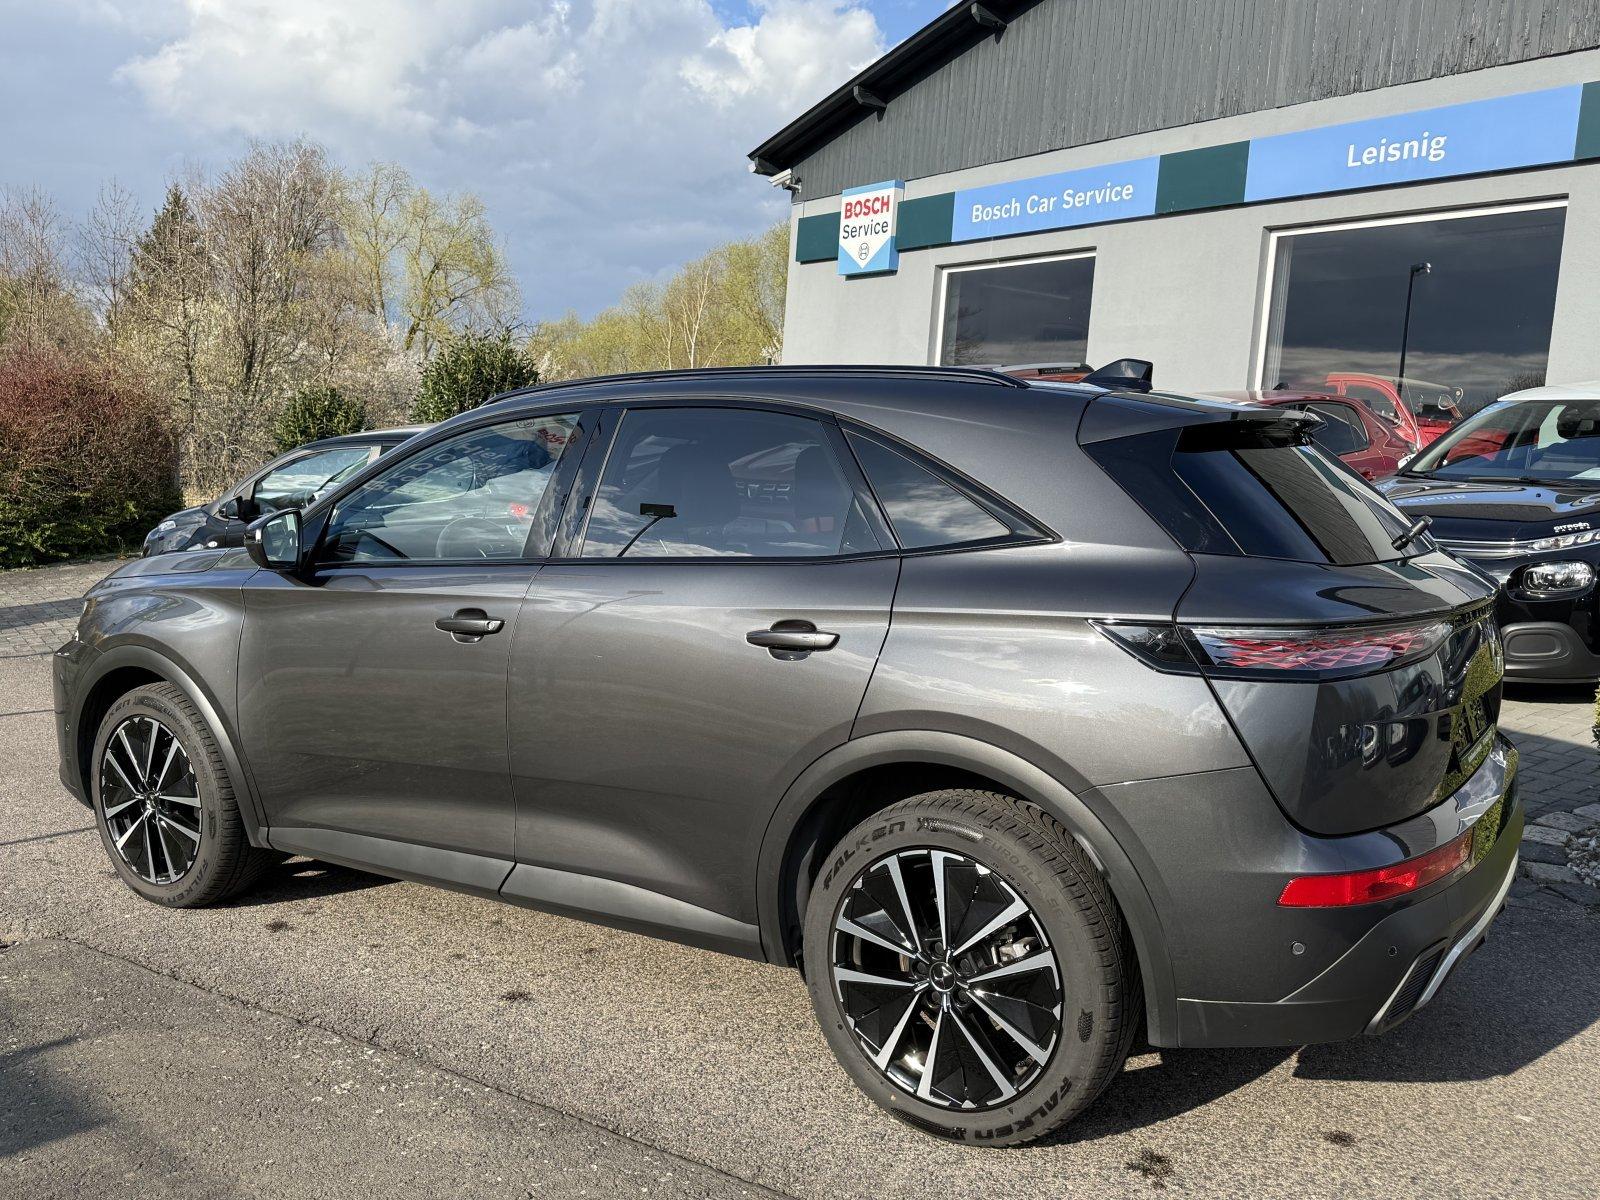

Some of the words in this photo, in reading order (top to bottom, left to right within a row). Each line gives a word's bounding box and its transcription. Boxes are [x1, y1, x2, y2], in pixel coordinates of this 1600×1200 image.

[1347, 131, 1447, 168] Leisnig
[844, 195, 890, 220] BOSCH
[971, 197, 1021, 223] Bosch
[1026, 194, 1058, 215] Car
[1062, 182, 1134, 210] Service
[842, 218, 889, 240] Service
